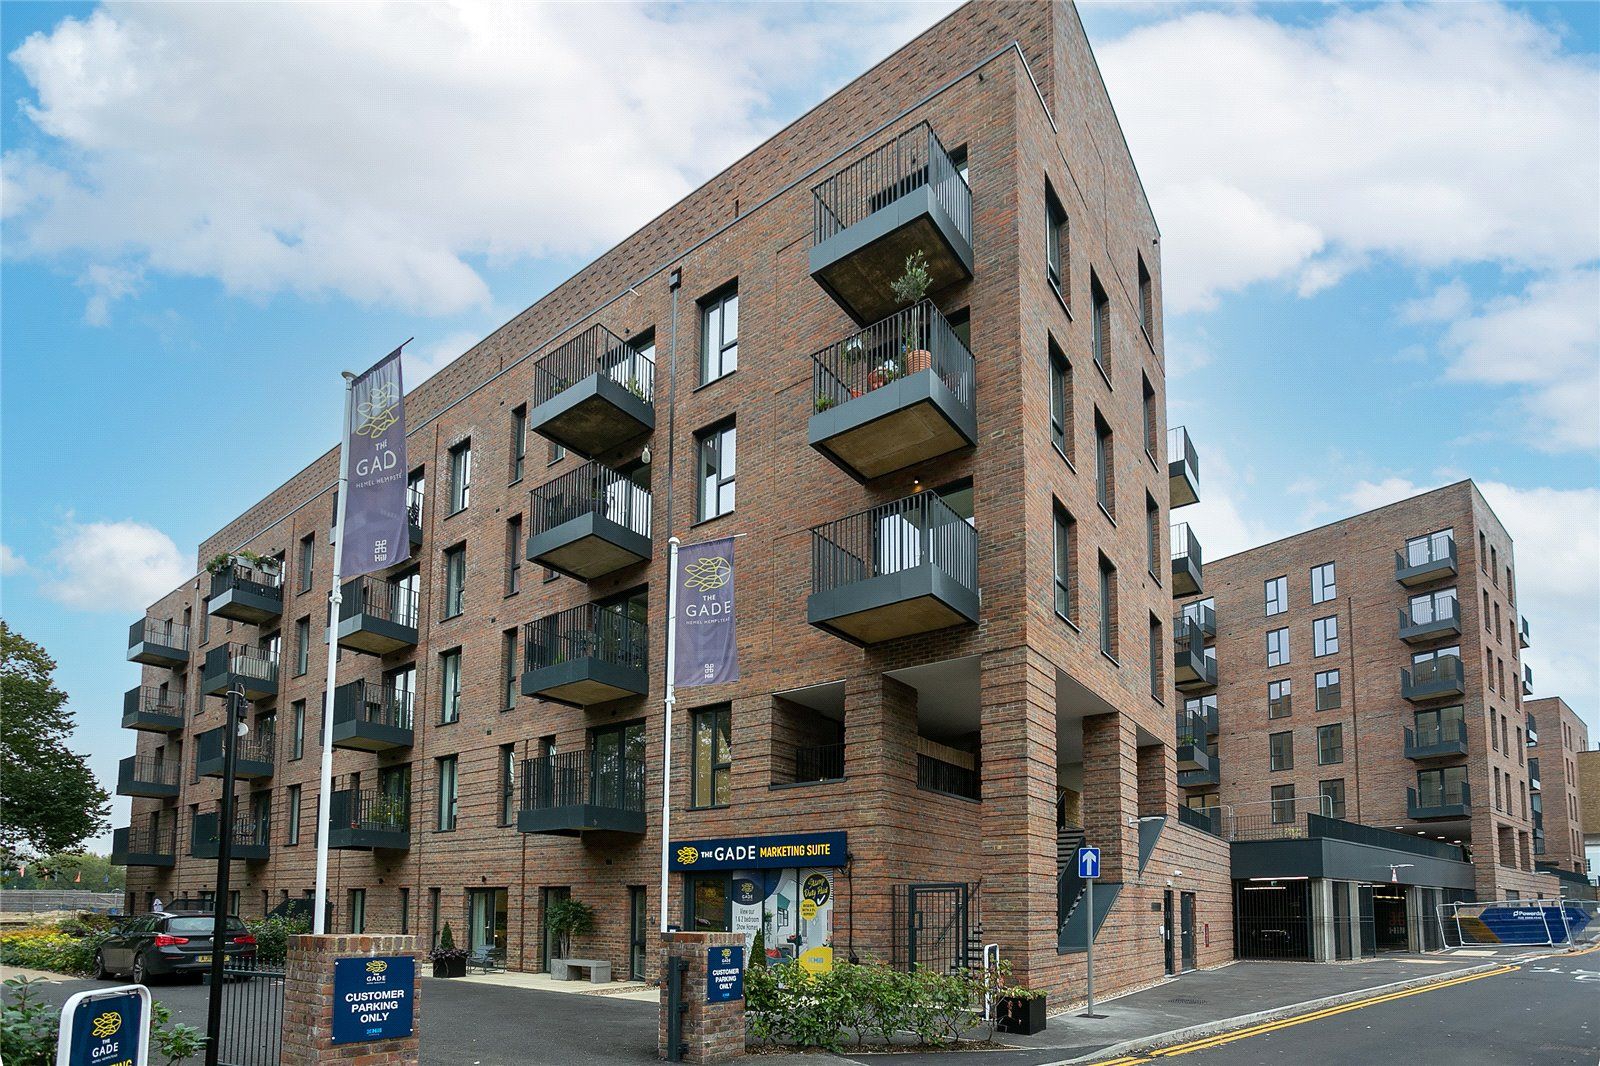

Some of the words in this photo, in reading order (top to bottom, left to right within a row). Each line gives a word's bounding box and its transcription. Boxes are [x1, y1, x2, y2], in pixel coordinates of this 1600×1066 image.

[375, 439, 388, 451] THE
[356, 450, 397, 476] GAD
[376, 472, 402, 484] HEMPSTE
[374, 553, 387, 562] Hill
[702, 594, 716, 602] THE
[685, 600, 731, 617] GADE
[714, 845, 756, 861] GADE
[760, 845, 805, 858] MARKETING
[806, 843, 831, 856] SUITE
[712, 968, 740, 976] CUSTOMER
[715, 975, 737, 983] PARKING
[345, 989, 405, 1002] CUSTOMER
[351, 1001, 399, 1013] PARKING
[360, 1012, 390, 1023] ONLY
[92, 1042, 119, 1058] GADE
